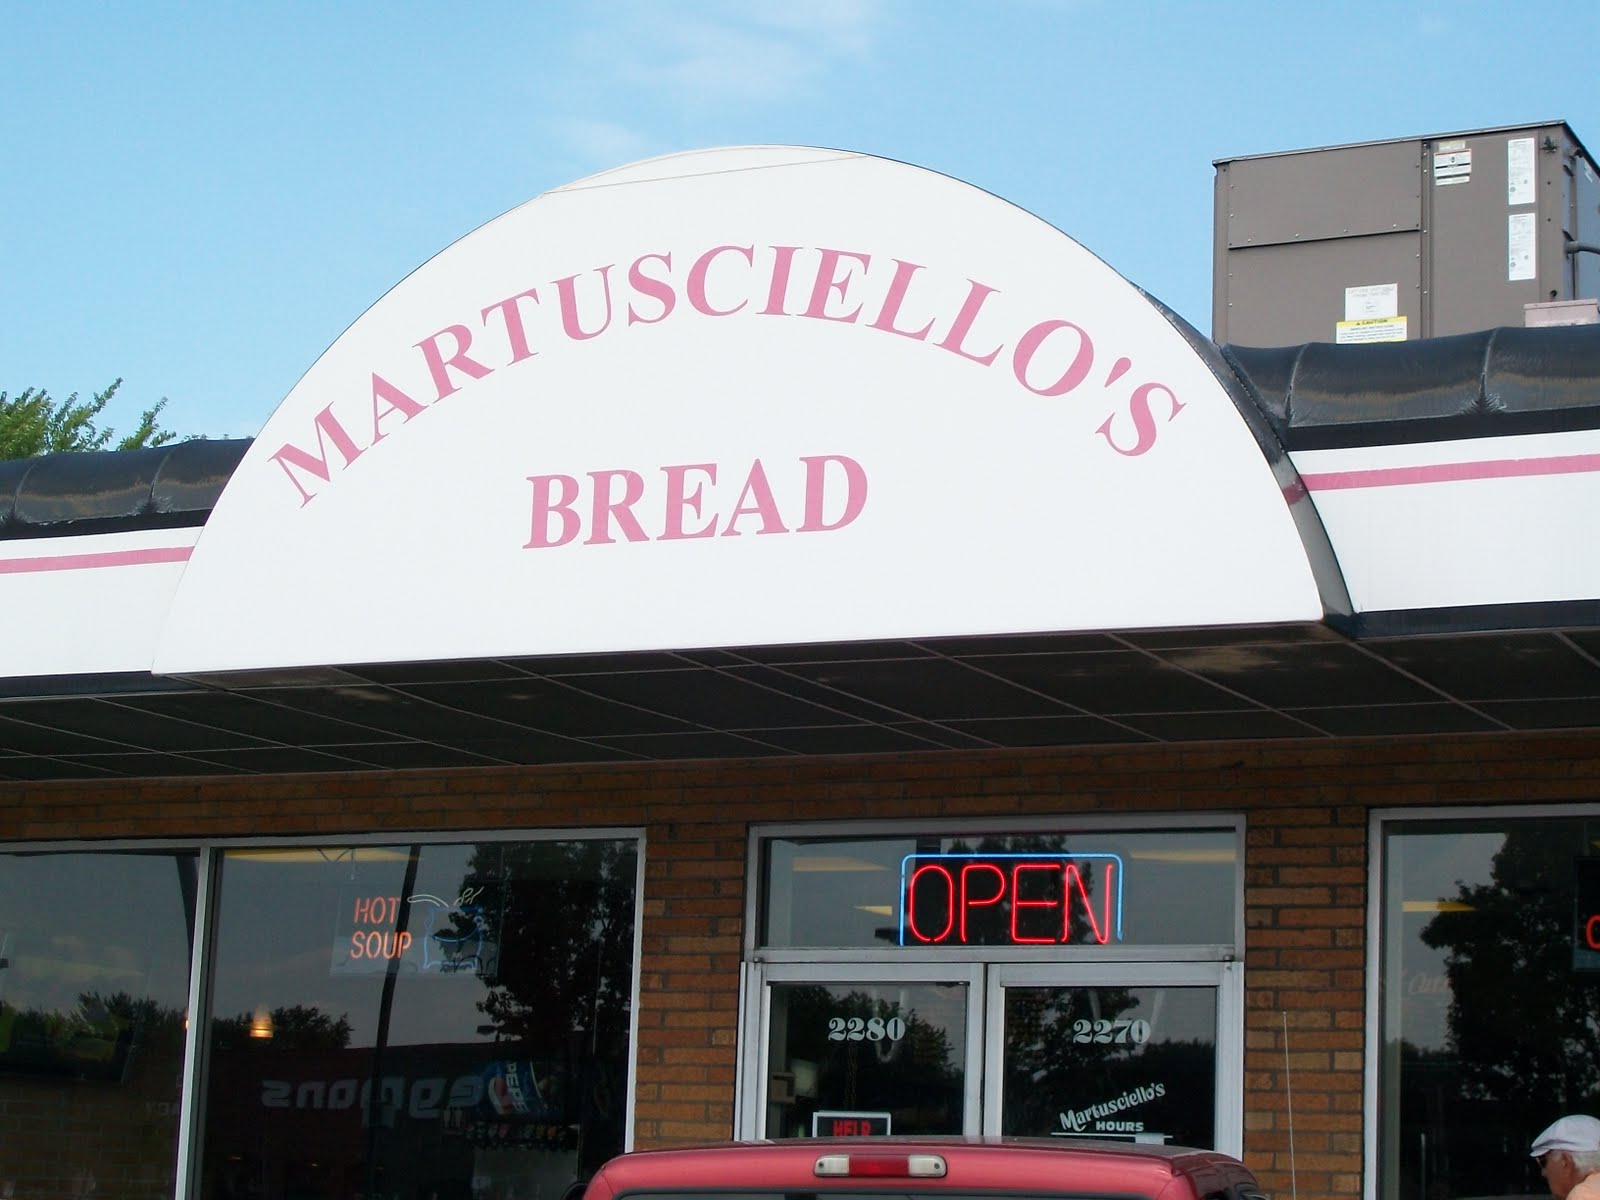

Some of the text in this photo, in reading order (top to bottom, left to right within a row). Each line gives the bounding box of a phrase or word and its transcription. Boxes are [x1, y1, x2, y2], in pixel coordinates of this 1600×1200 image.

[267, 245, 1187, 509] MARTUSCIELLO'S
[522, 454, 869, 549] BREAD
[353, 896, 401, 924] HOT
[908, 863, 1114, 945] OPEN
[350, 930, 412, 960] SOUP
[827, 1017, 906, 1041] 2280
[1072, 1019, 1151, 1044] 2270
[1059, 1082, 1166, 1133] Martusciello's
[833, 1120, 872, 1137] HELP
[1095, 1121, 1144, 1132] HOURS
